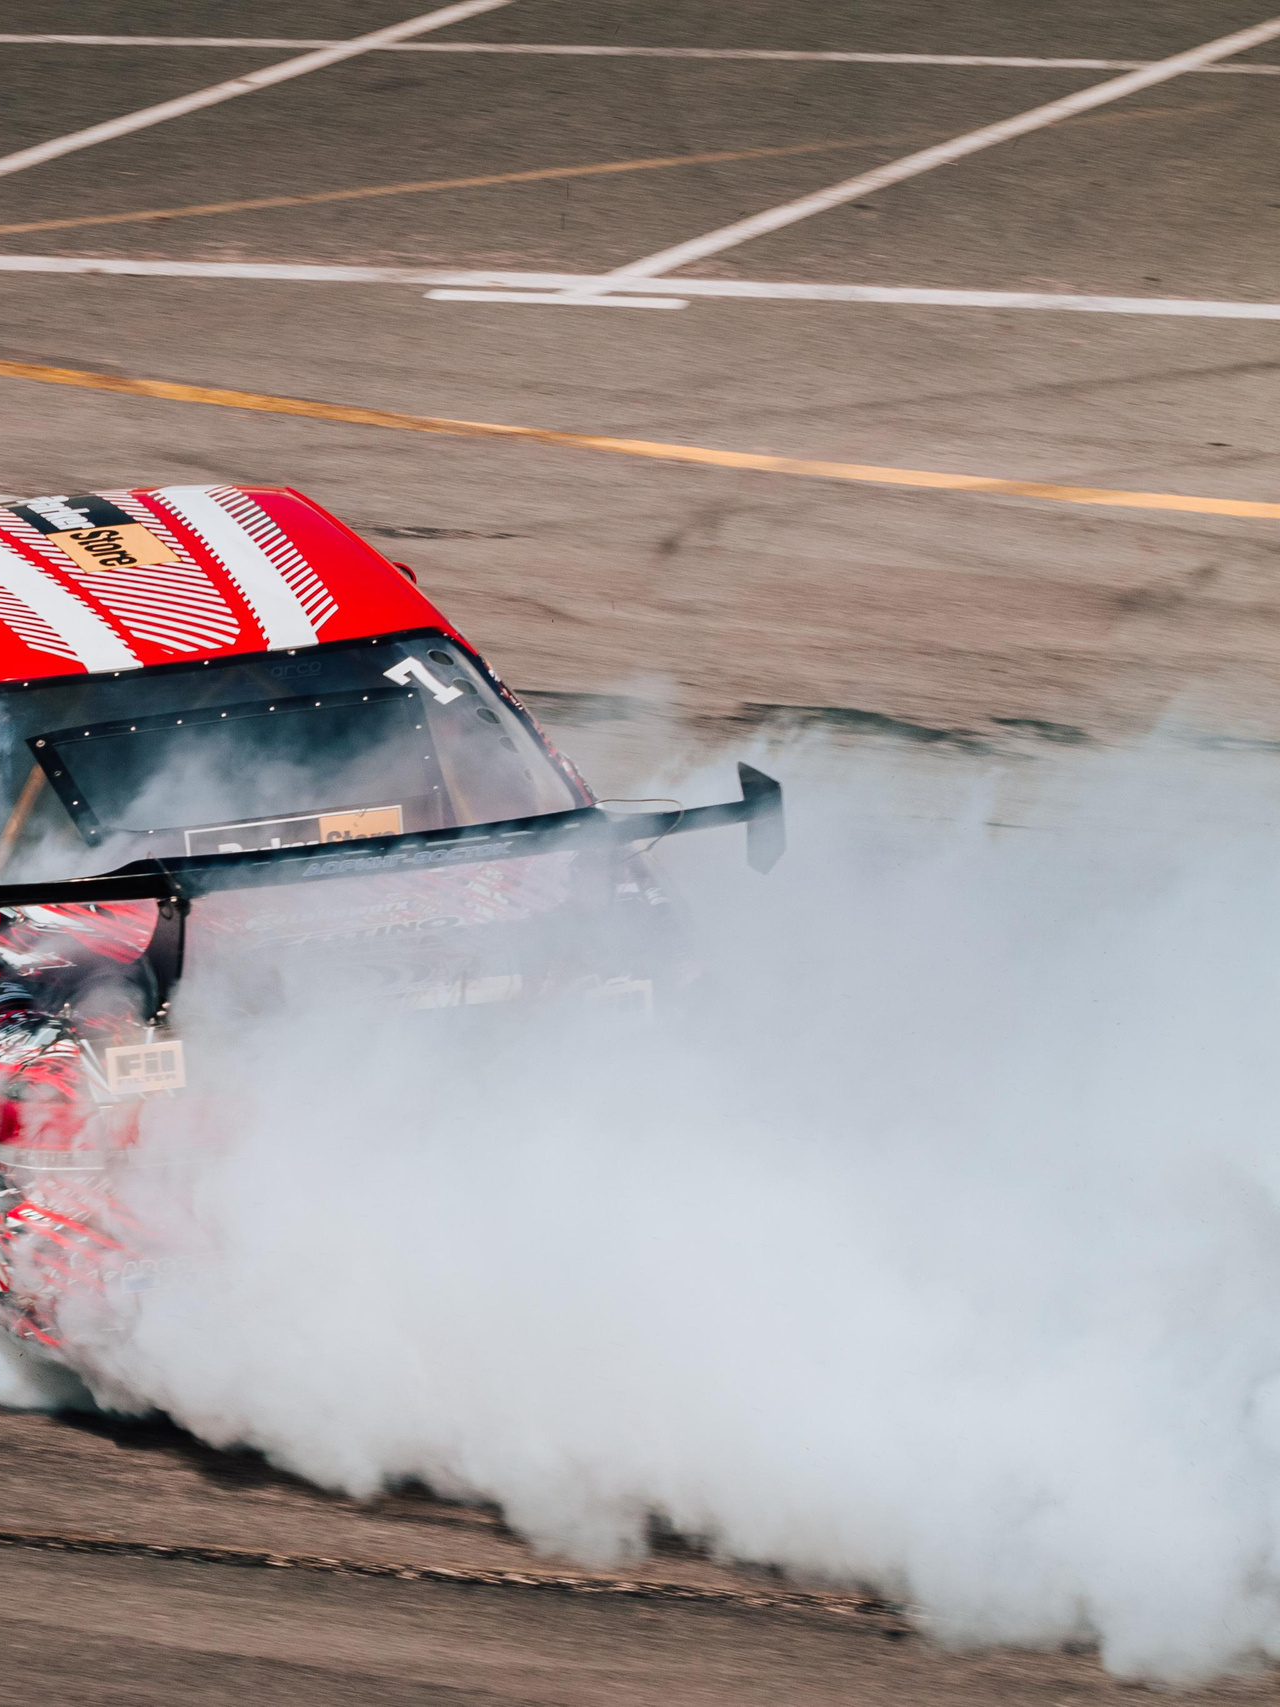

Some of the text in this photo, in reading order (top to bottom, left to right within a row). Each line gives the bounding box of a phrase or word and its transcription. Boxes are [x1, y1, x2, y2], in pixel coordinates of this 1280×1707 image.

[70, 529, 138, 567] Store
[382, 656, 463, 705] 7
[115, 1049, 175, 1077] Fil
